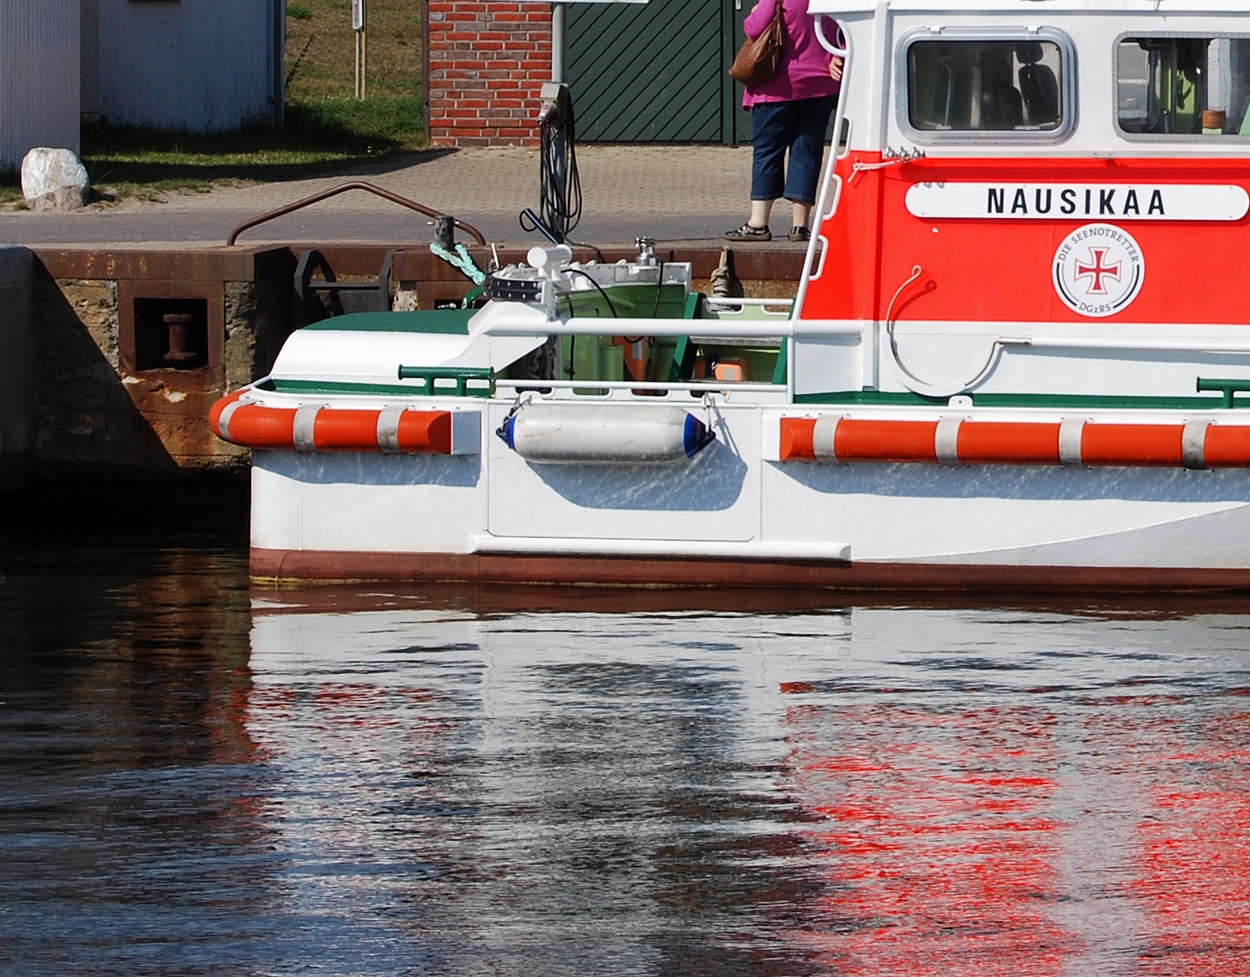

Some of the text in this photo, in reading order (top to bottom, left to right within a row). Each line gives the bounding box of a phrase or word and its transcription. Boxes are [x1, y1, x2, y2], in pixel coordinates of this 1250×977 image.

[987, 188, 1165, 215] NAUSIKAA
[1057, 227, 1139, 263] DIE SEENOTRETTER
[1078, 302, 1112, 314] DGzRS
